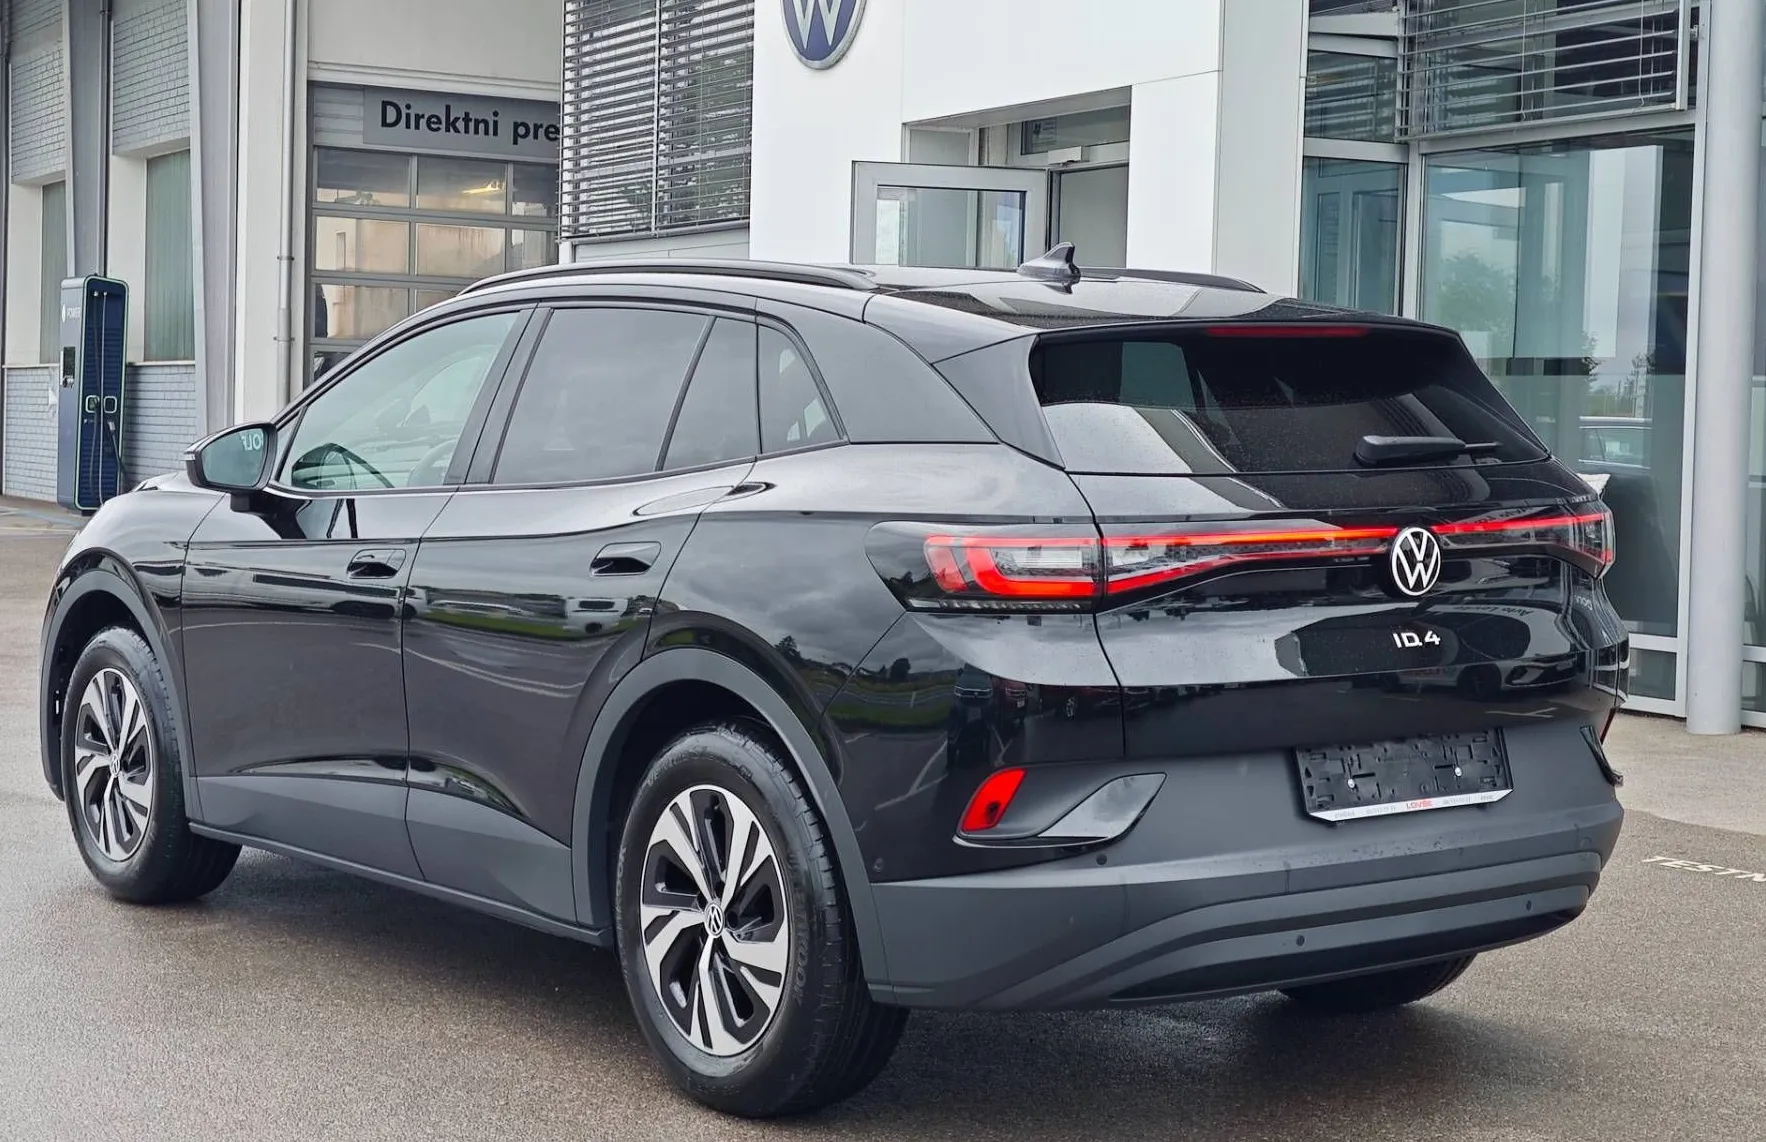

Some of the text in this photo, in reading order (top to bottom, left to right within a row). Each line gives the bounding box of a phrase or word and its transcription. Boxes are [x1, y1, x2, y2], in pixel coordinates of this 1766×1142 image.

[381, 100, 561, 146] Direktni pre
[1394, 529, 1439, 593] VW
